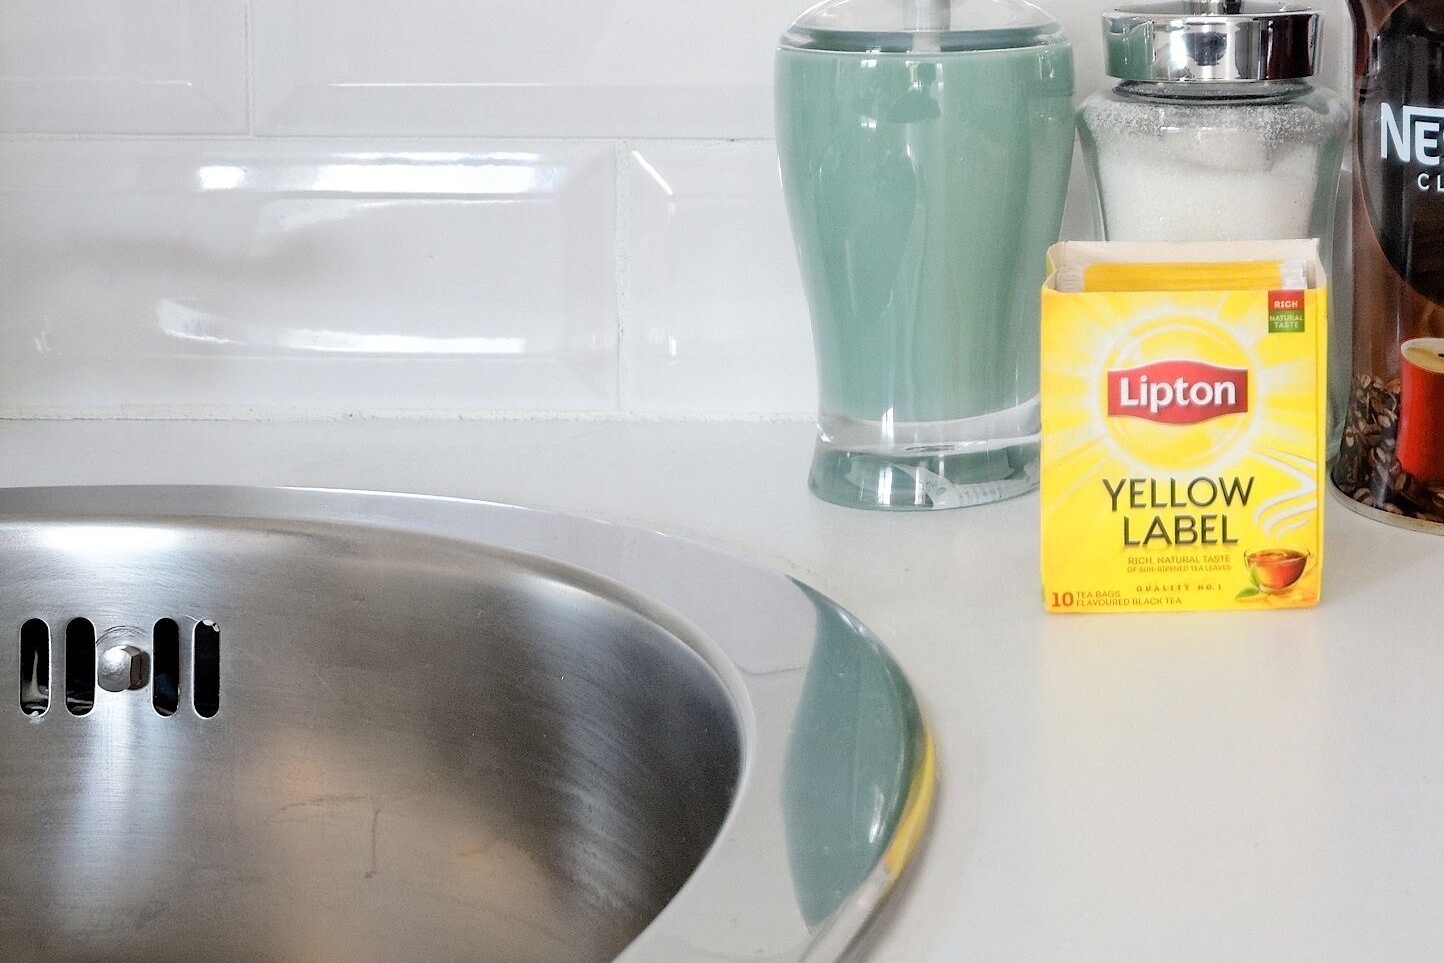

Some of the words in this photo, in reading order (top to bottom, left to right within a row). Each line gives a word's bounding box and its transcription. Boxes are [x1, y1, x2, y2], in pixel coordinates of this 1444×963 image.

[1273, 300, 1299, 308] RICH
[1120, 374, 1237, 414] Lipton
[1102, 476, 1255, 512] YELLOW
[1123, 514, 1239, 546] LABEL
[1157, 556, 1202, 564] NATURAL
[1203, 555, 1231, 563] TASTE
[1051, 591, 1074, 607] 10
[1095, 590, 1121, 598] BAGS
[1076, 598, 1130, 606] FLAVOURED
[1132, 598, 1163, 606] BLACK
[1165, 597, 1182, 605] TEA
